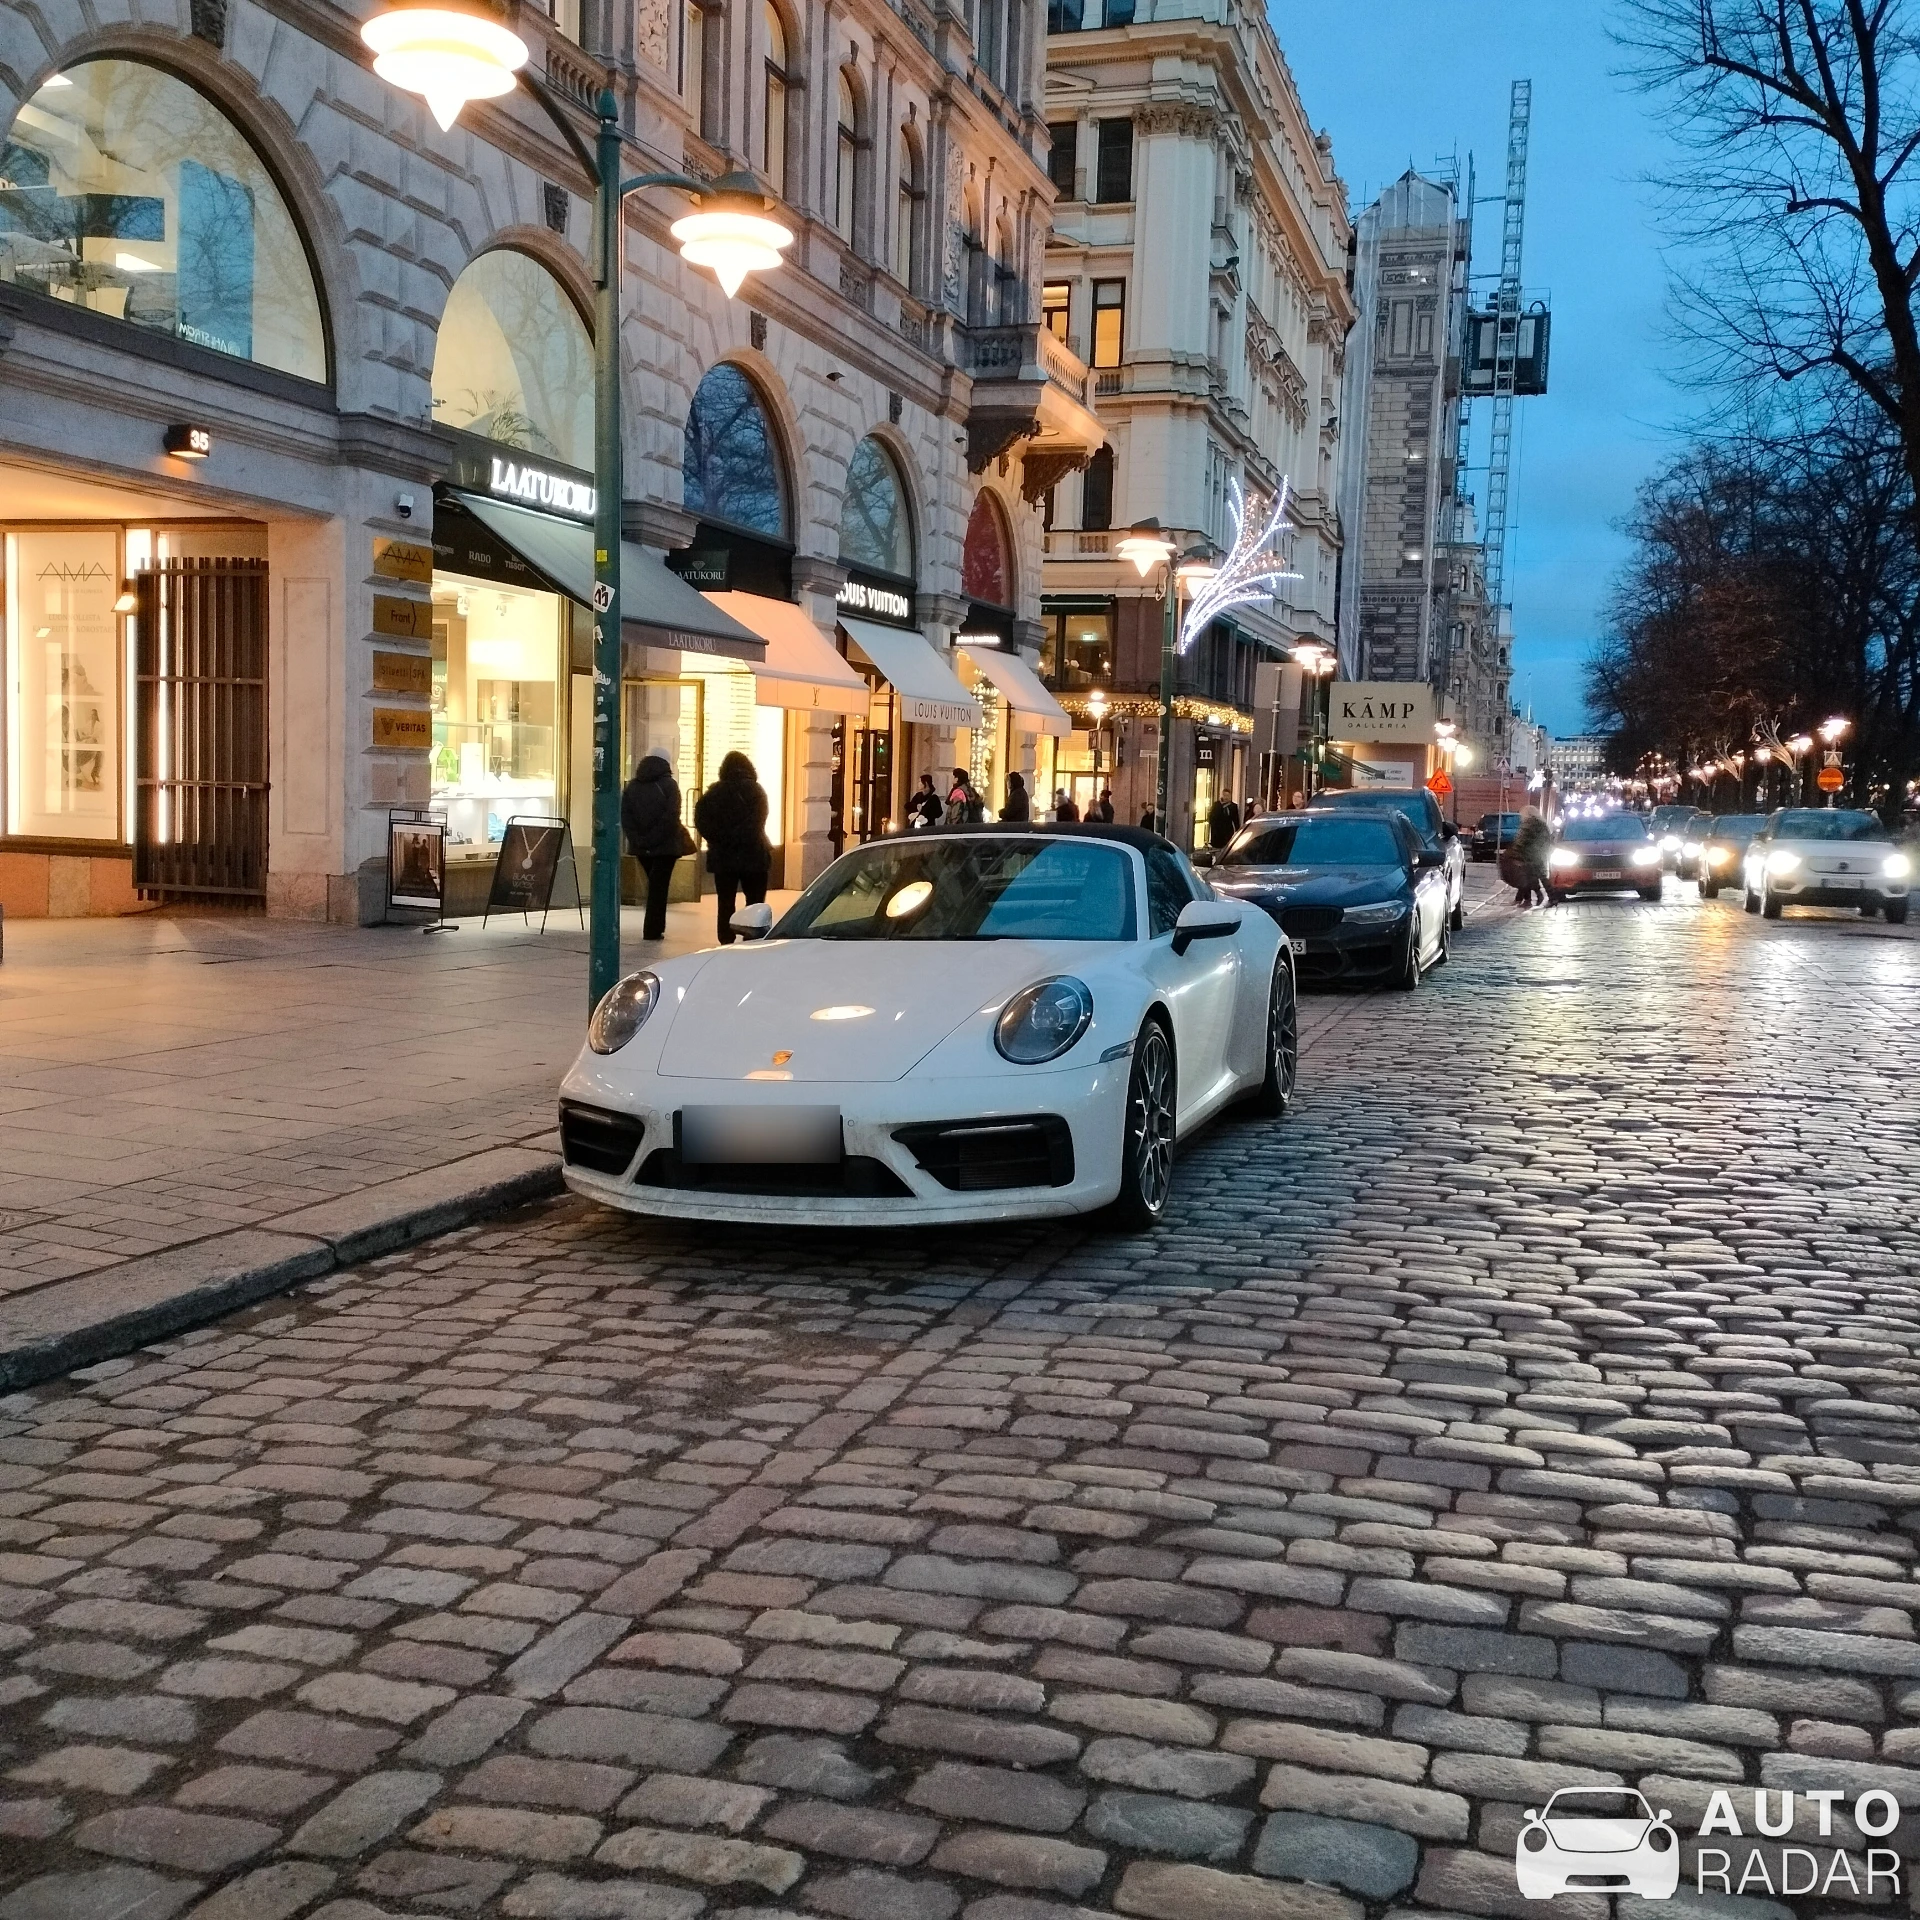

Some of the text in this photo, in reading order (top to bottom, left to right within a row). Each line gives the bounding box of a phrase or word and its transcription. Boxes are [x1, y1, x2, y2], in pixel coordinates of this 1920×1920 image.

[190, 429, 209, 451] 35
[382, 545, 426, 568] AMA
[468, 550, 492, 564] RADO
[36, 561, 113, 582] AMA
[505, 560, 526, 572] TISSOT
[835, 582, 908, 618] OUIS VUITTON
[390, 609, 411, 624] Front
[668, 631, 717, 652] LAATUKORU
[914, 701, 972, 722] LOUIS VUITTON
[395, 722, 427, 733] VERITAS
[1199, 749, 1213, 760] m
[512, 872, 536, 881] BLACK
